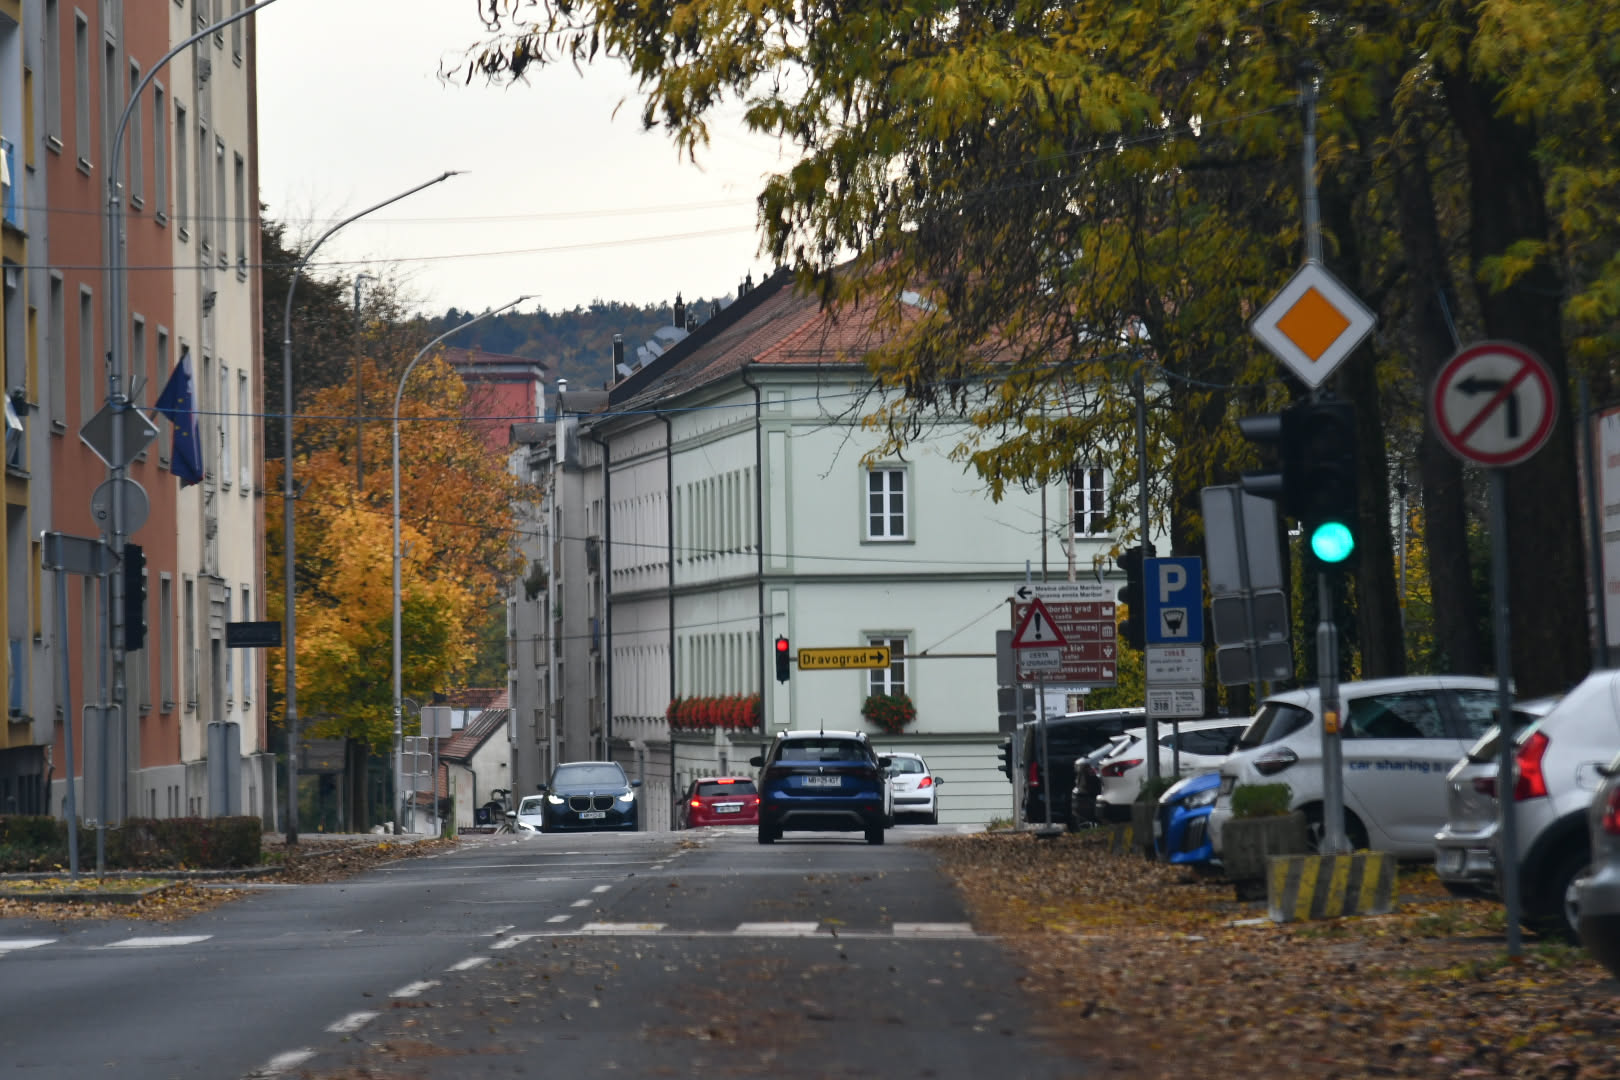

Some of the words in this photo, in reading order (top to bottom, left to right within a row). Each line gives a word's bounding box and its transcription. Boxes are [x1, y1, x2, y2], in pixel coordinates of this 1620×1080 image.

[1159, 564, 1187, 602] P
[1074, 604, 1092, 614] grad
[1076, 624, 1098, 633] muzej
[803, 653, 867, 667] Dravograd
[1349, 762, 1369, 771] car
[1376, 759, 1430, 774] sharing
